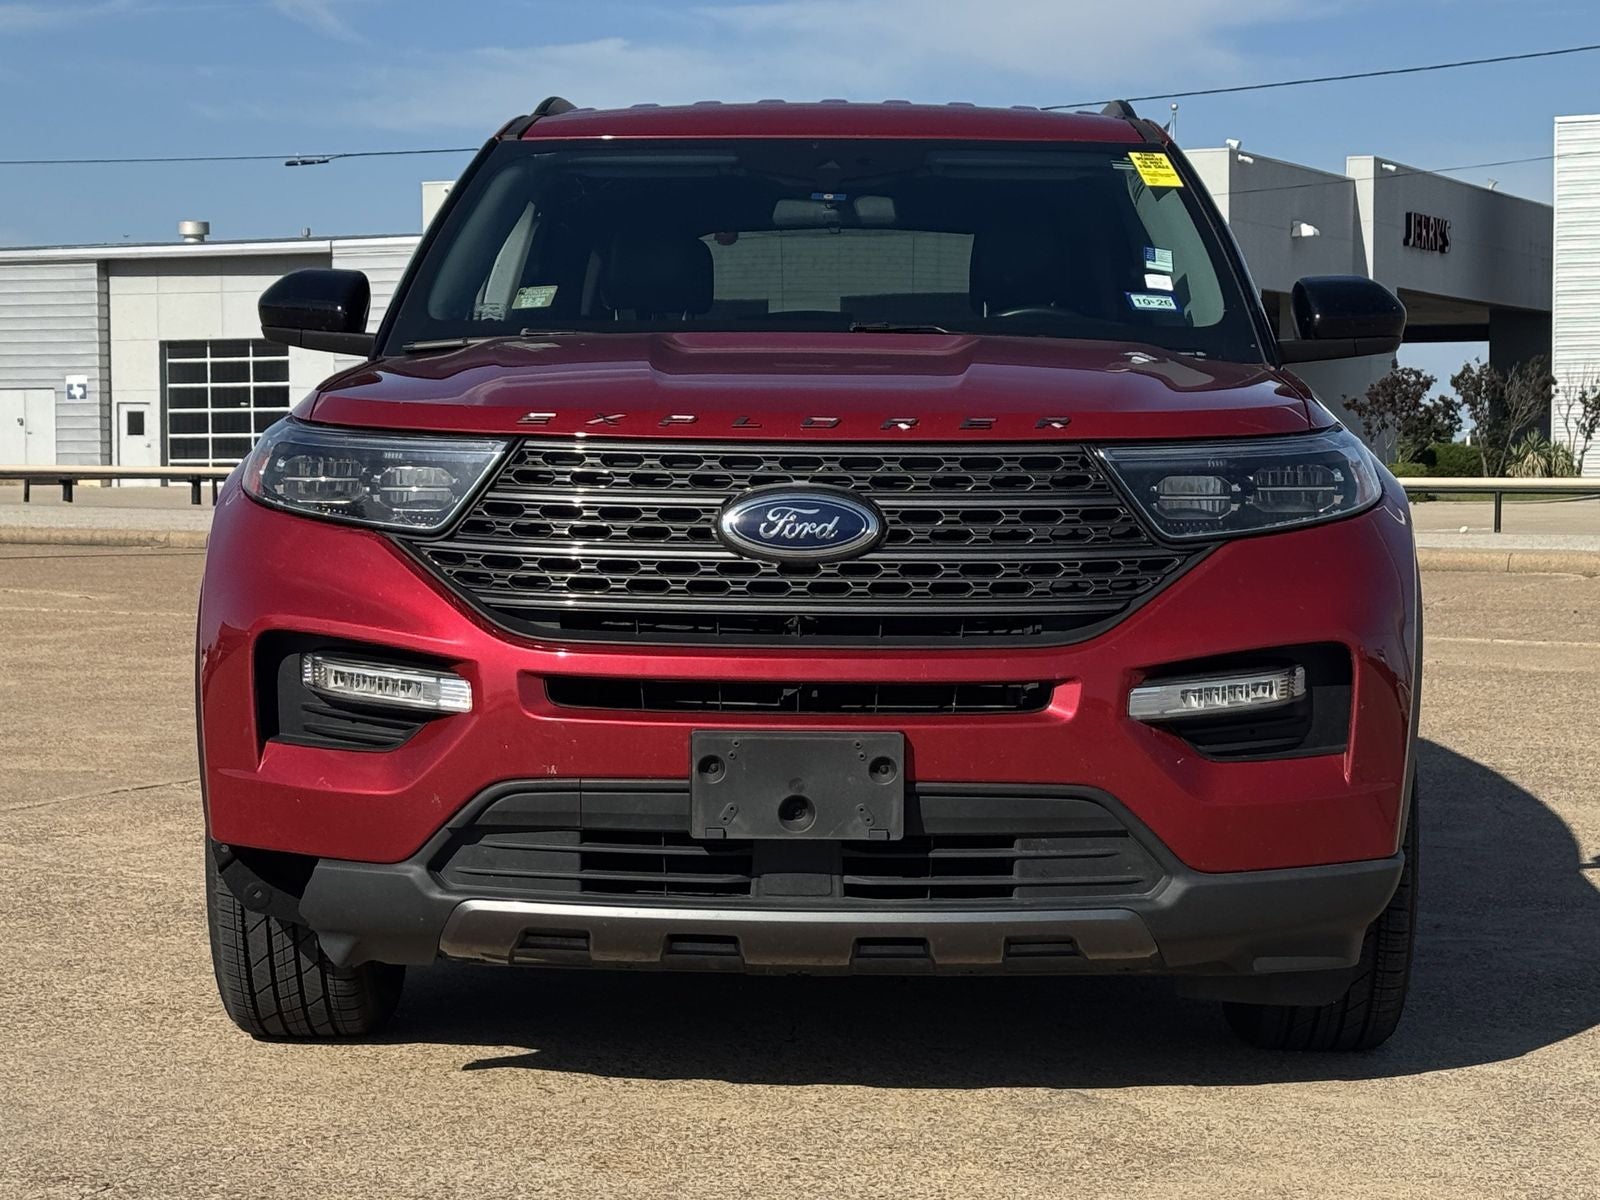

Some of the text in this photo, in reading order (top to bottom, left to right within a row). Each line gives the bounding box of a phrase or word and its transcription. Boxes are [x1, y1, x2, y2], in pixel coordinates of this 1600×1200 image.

[1403, 211, 1452, 254] JERRY'S
[516, 411, 1072, 430] EXPLORER
[758, 506, 840, 540] Ford
